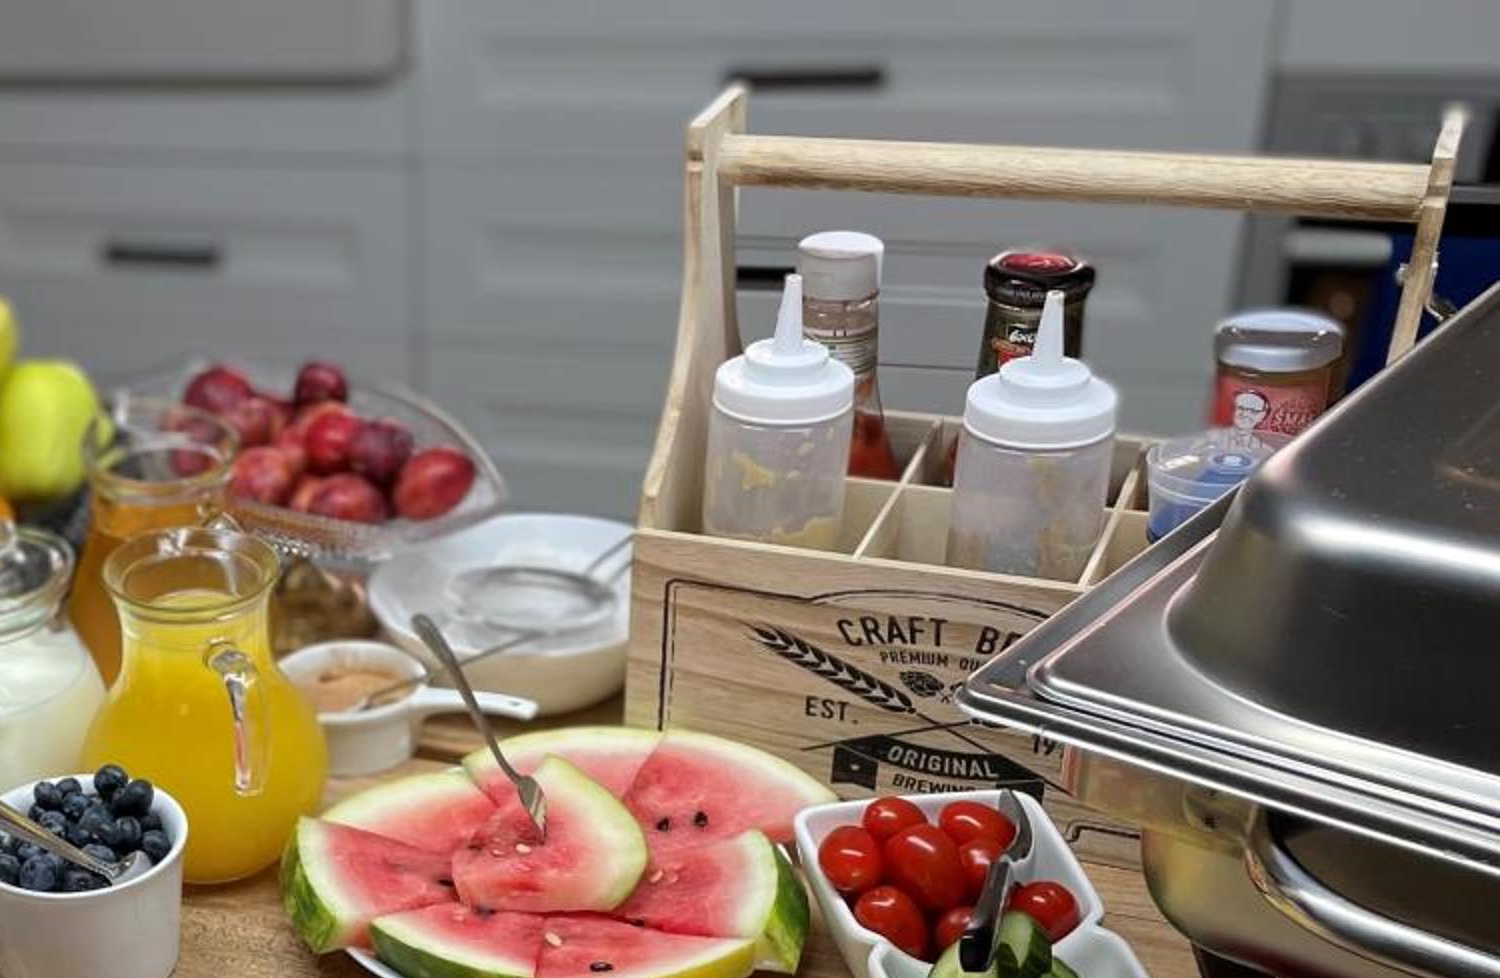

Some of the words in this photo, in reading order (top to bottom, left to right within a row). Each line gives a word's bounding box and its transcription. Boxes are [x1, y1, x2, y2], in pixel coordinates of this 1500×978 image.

[836, 615, 949, 648] CRAFT
[879, 651, 949, 668] PREMIUM
[805, 695, 858, 725] EST.
[887, 745, 998, 779] ORIGINAL
